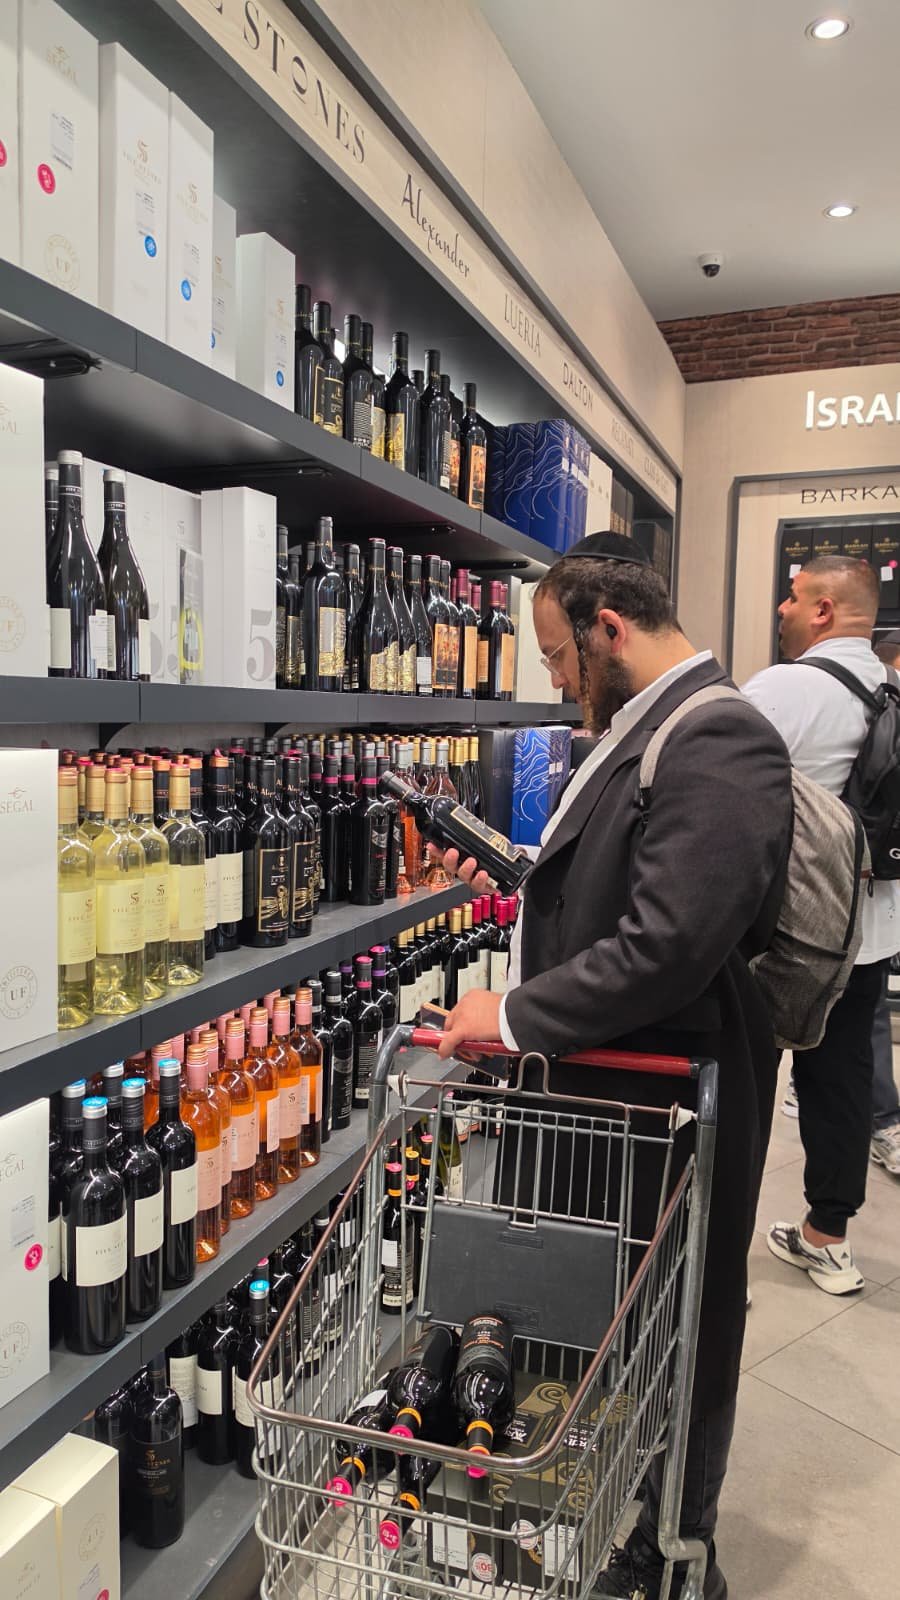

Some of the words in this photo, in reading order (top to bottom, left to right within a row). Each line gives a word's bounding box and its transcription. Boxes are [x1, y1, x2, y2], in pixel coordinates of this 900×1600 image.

[242, 0, 366, 164] STONES
[401, 174, 471, 279] Alexander
[503, 294, 542, 358] LUERIA
[562, 362, 594, 412] DALTON
[805, 390, 900, 430] ISRA
[246, 608, 275, 681] 5
